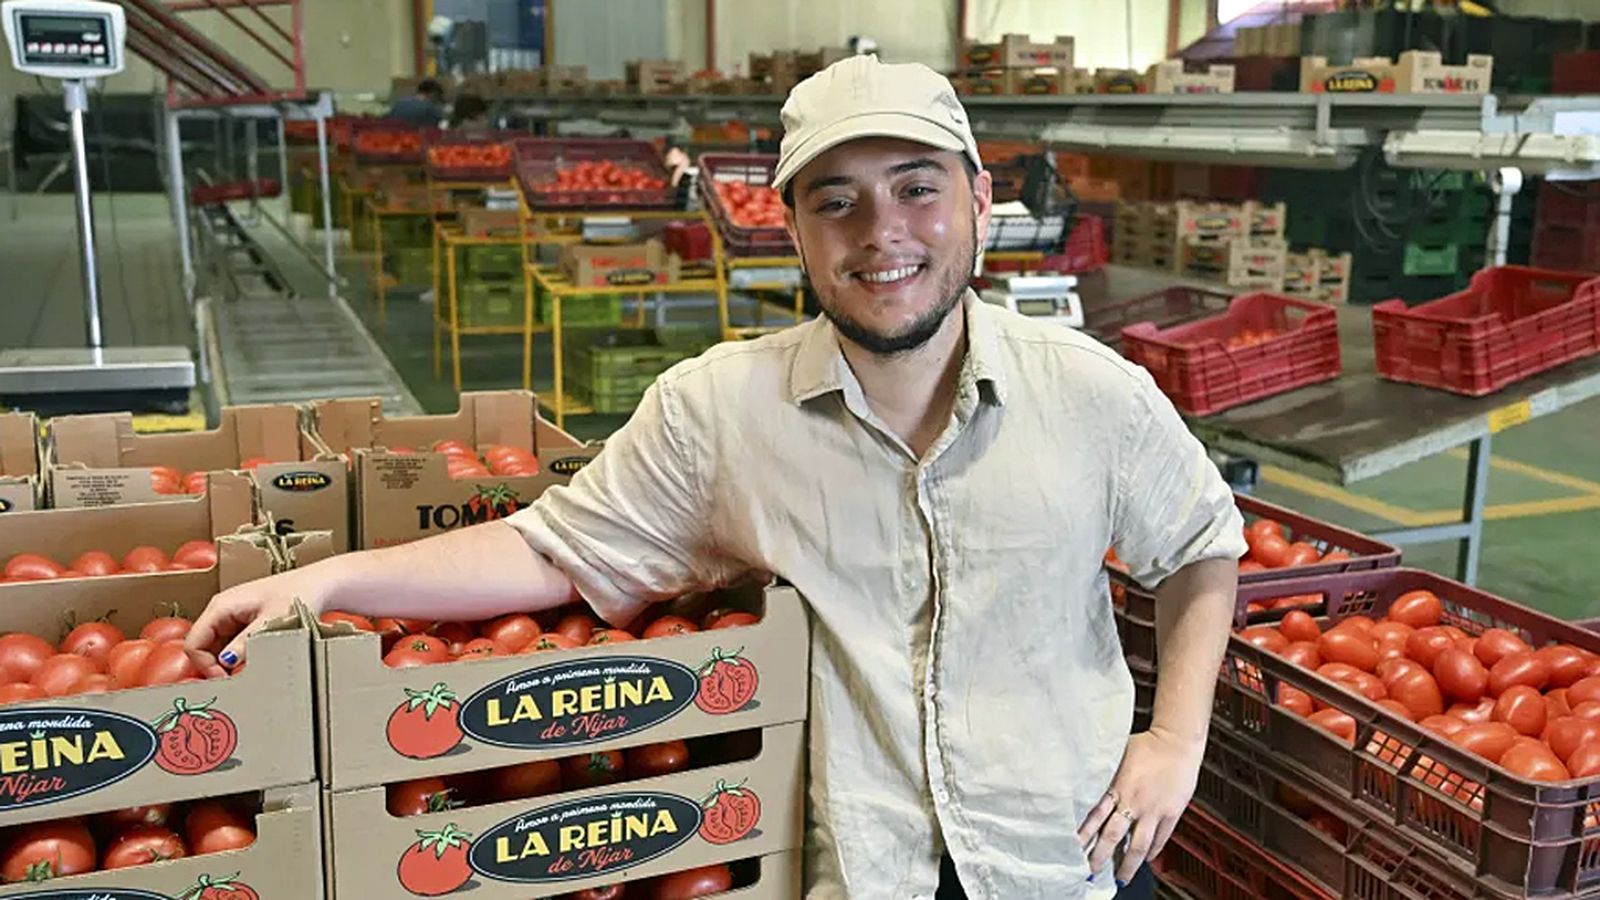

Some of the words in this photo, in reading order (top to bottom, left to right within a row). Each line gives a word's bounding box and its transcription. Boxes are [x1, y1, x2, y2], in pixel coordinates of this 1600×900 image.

[279, 477, 293, 487] LA
[487, 694, 543, 727] LA
[552, 675, 674, 718] REINA
[540, 721, 567, 740] de
[496, 831, 550, 863] LA
[559, 809, 678, 852] REINA
[547, 855, 574, 874] de
